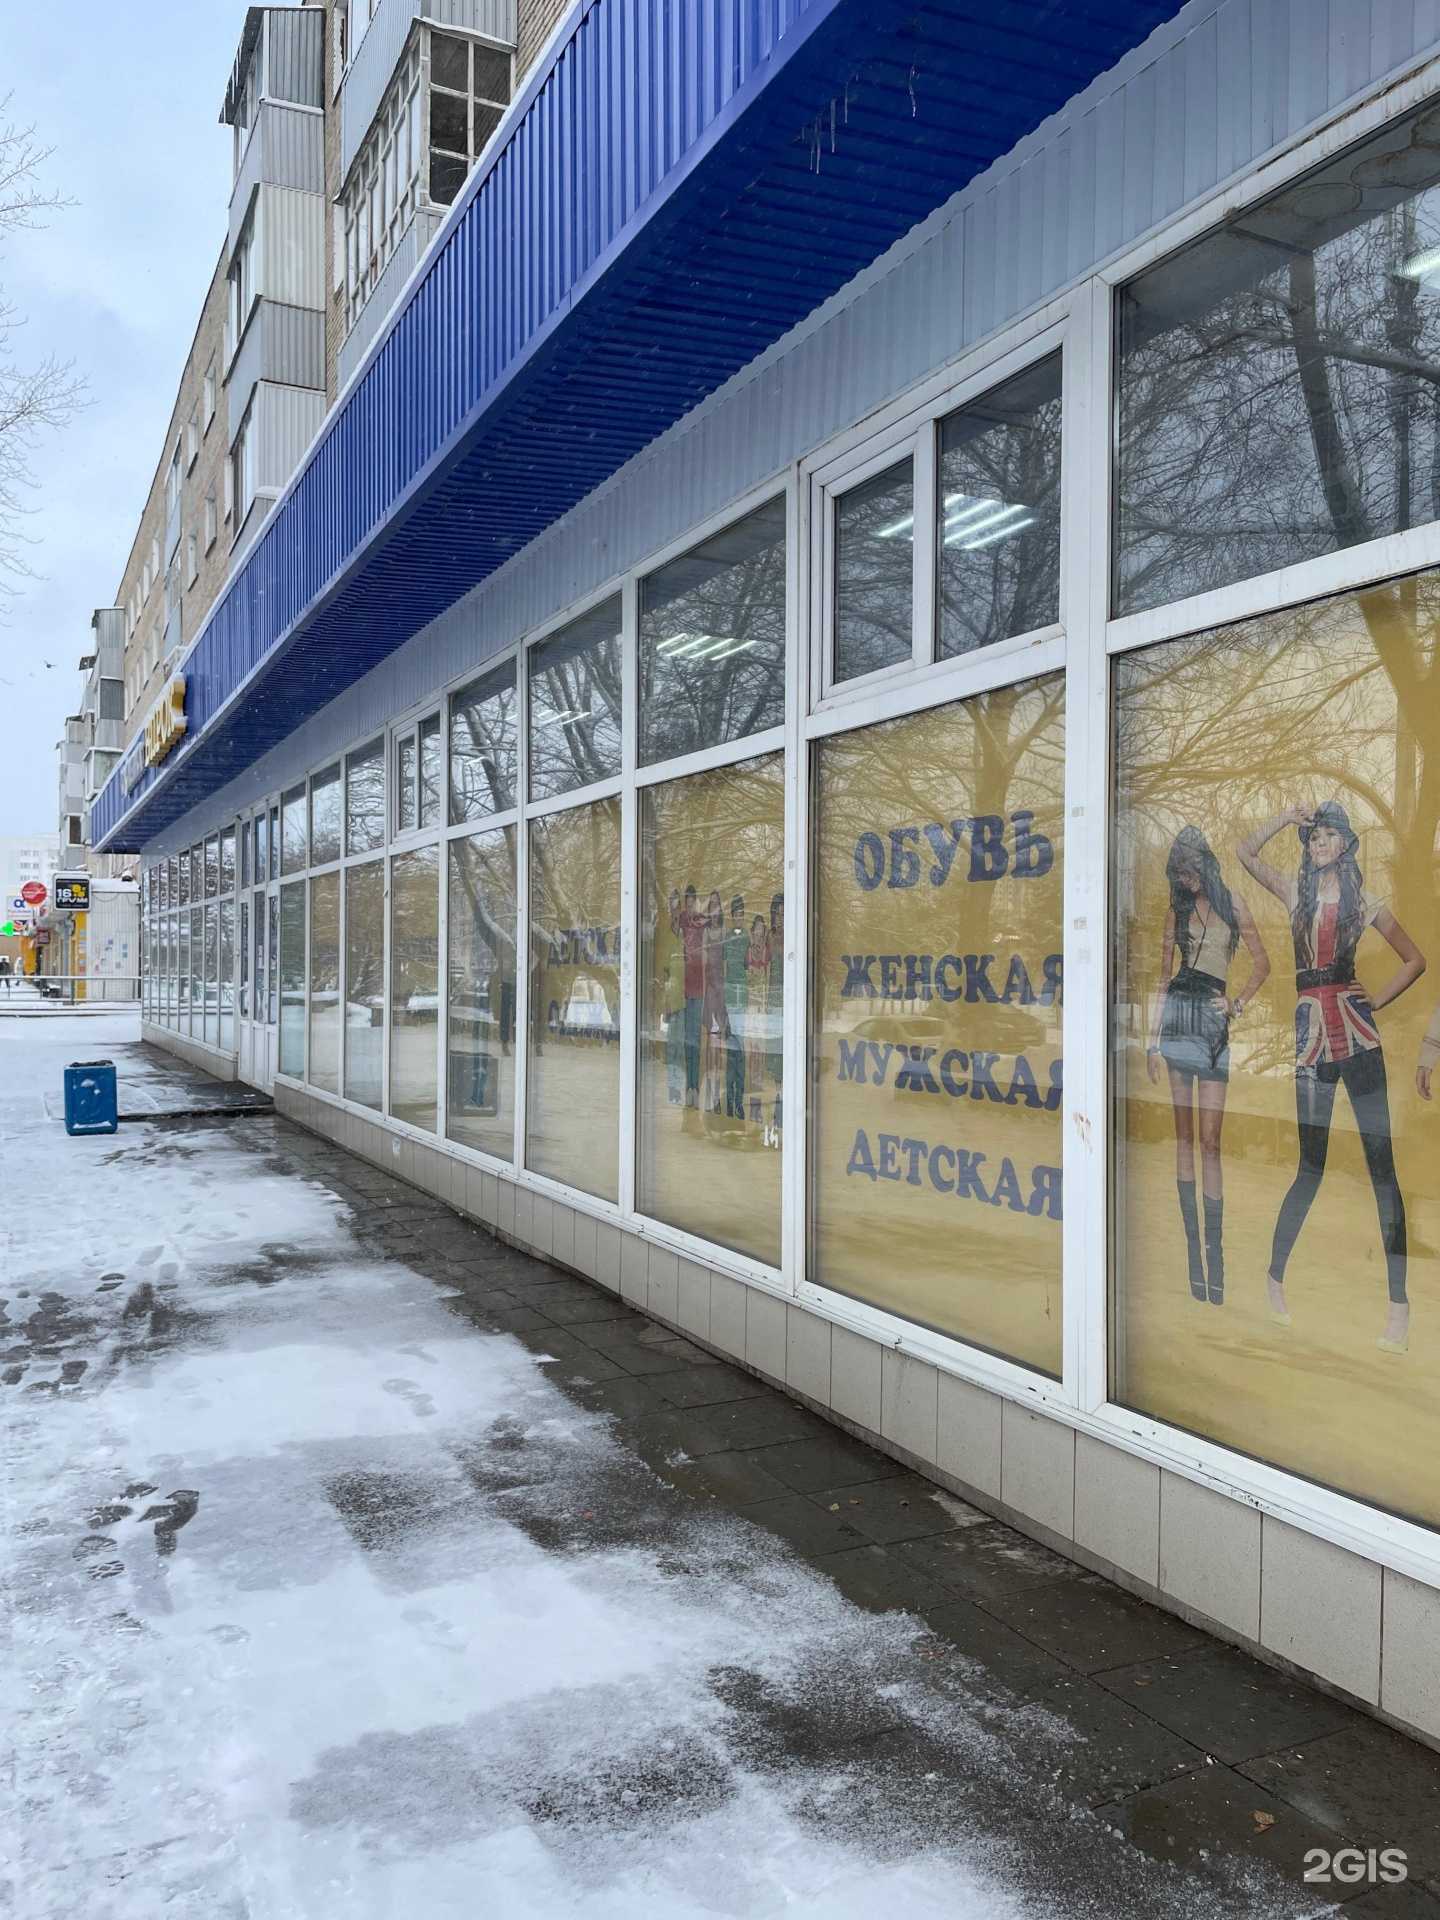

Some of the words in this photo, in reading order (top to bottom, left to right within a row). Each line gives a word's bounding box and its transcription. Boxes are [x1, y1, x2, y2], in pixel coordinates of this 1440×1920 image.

[853, 809, 1055, 891] ОБУВЬ
[840, 954, 1064, 1007] ЖЕНСКАЯ
[846, 1128, 1064, 1221] ДЕТСКАЯ
